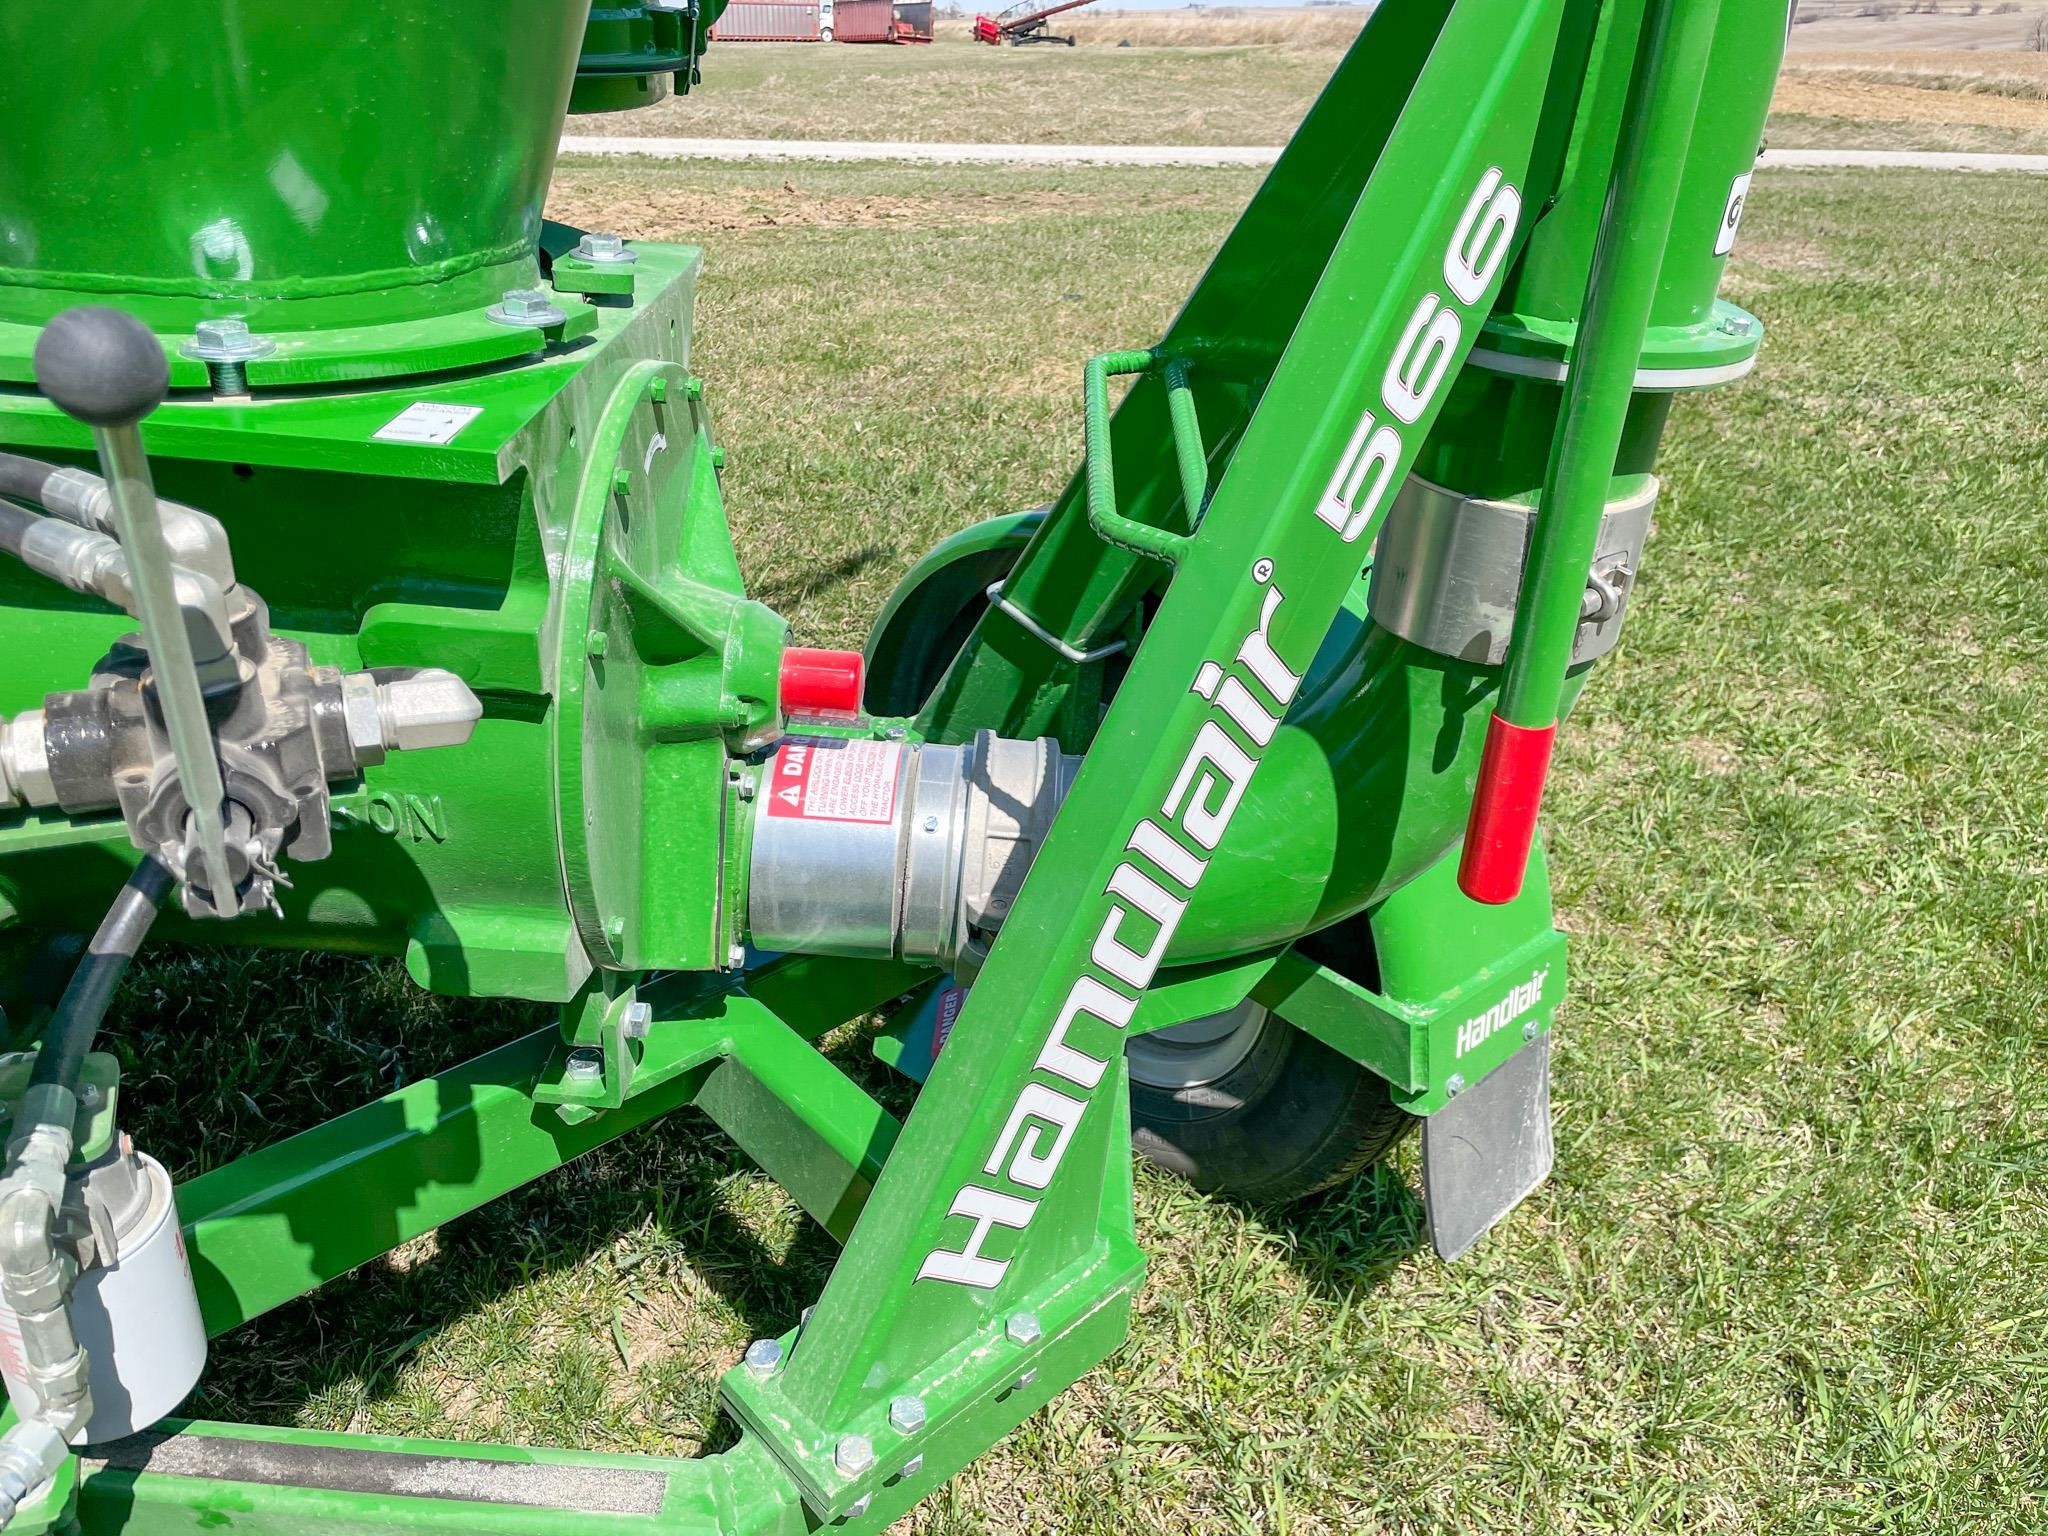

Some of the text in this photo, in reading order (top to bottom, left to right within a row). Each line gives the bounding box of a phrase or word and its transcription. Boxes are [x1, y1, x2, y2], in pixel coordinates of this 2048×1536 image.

[1314, 165, 1522, 542] 566
[849, 783, 860, 816] ACCESS
[859, 800, 868, 816] OFF
[870, 801, 878, 817] THE
[880, 780, 891, 818] TRACTOR
